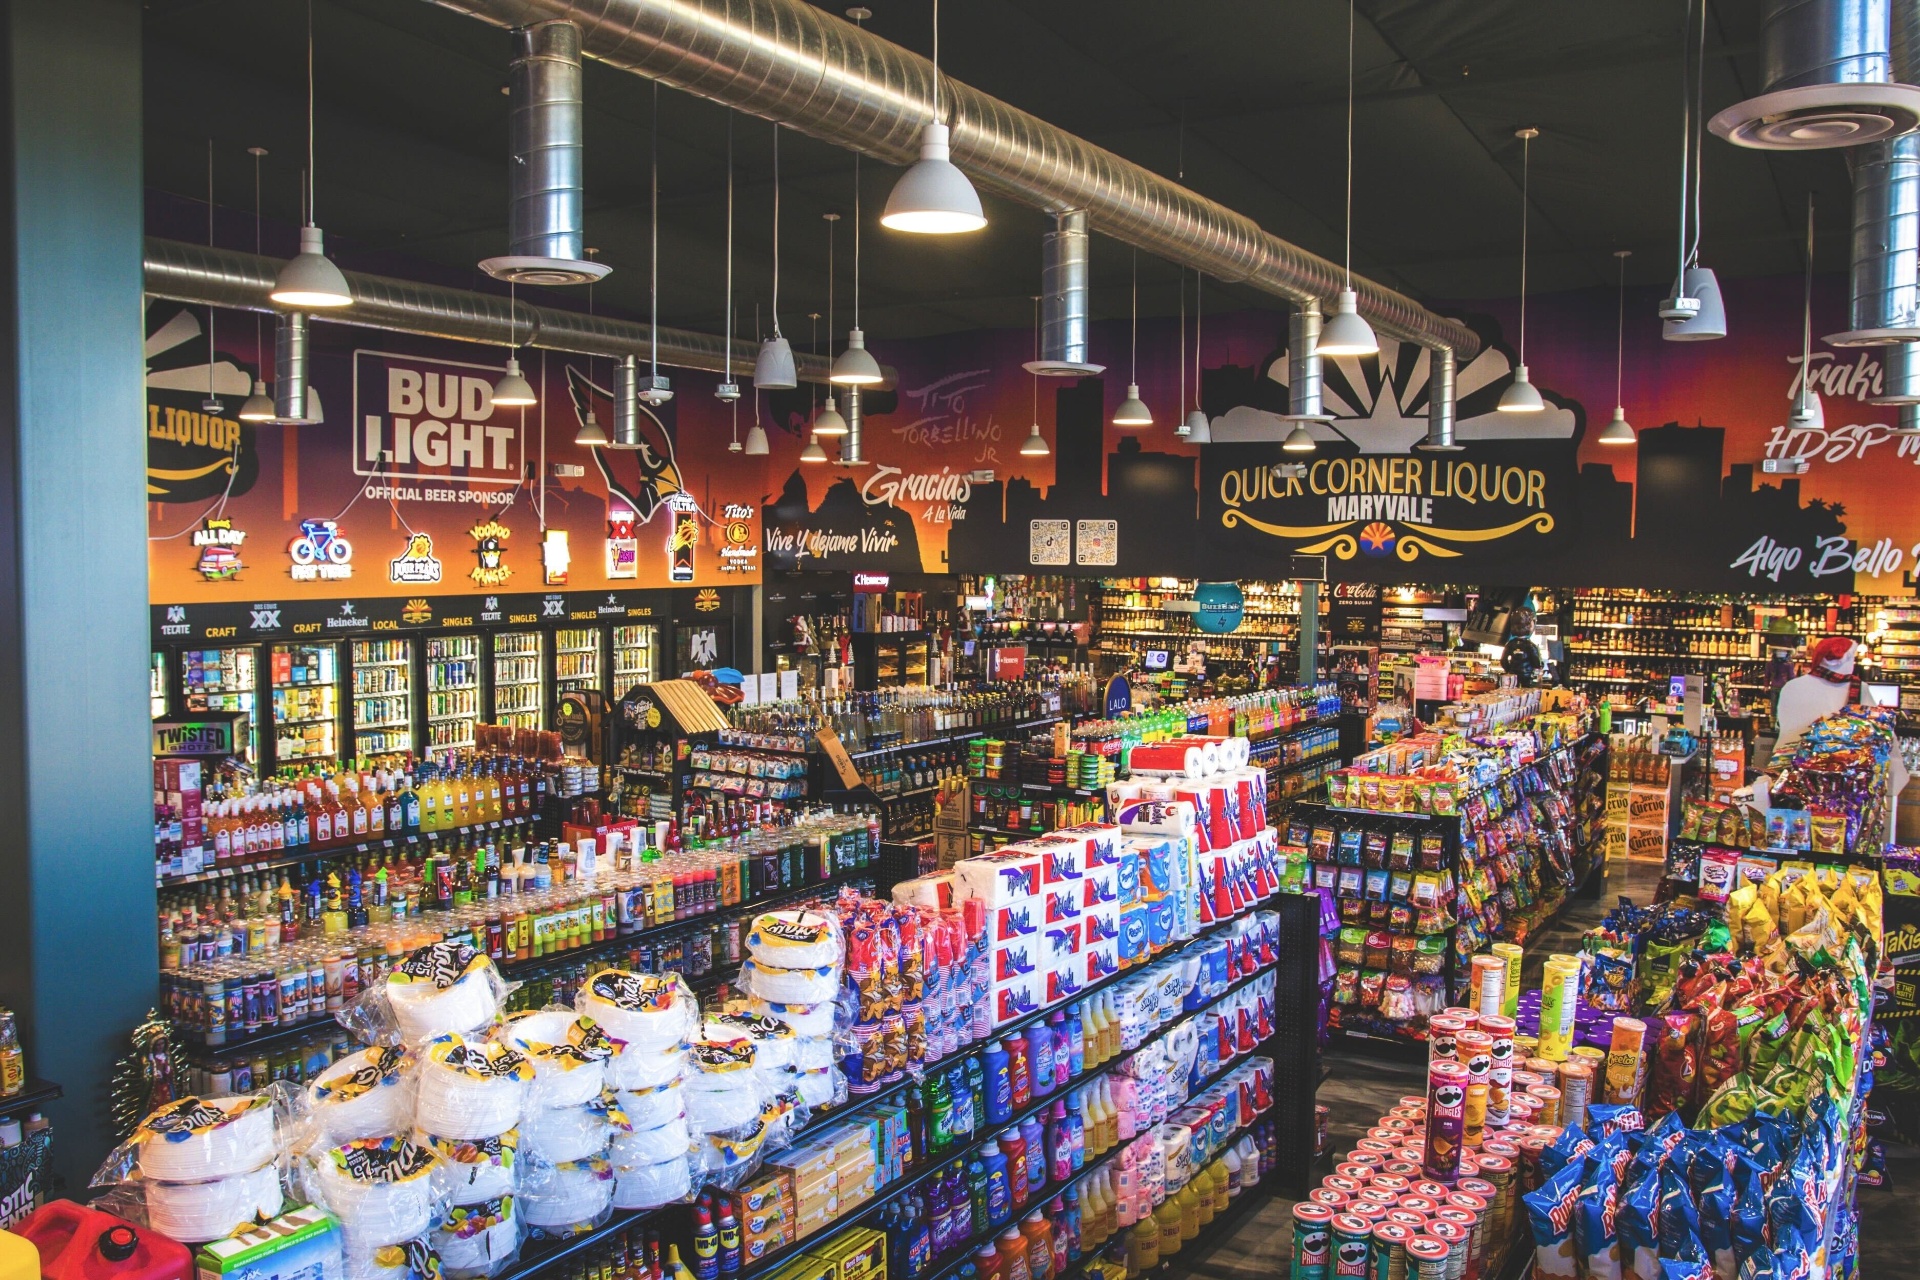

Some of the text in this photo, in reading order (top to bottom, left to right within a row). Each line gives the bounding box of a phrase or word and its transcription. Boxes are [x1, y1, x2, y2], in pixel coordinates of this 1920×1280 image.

[388, 368, 493, 422] BUD
[149, 404, 242, 452] LIQUOR
[365, 415, 514, 471] LIGHT
[862, 464, 973, 507] Gracias
[1221, 458, 1547, 509] QUICK CORNER LIQUOR
[365, 486, 514, 505] OFFICIAL BEER SPONSOR
[672, 500, 697, 512] ULTRA
[725, 504, 754, 518] Tito's
[934, 507, 945, 523] La
[947, 504, 966, 520] Vida
[1328, 494, 1433, 524] MARYVALE
[193, 529, 246, 546] ALL DAY
[470, 521, 511, 541] VOODOO
[766, 526, 897, 558] Vive Y dejame Vivir
[1730, 536, 1802, 582] Algo
[1810, 535, 1903, 578] Bello
[471, 565, 512, 584] RANGER
[1334, 582, 1378, 600] Coca-Cola
[542, 600, 565, 616] XX
[571, 611, 597, 620] SINGLES
[598, 604, 626, 614] Heineken
[627, 608, 651, 617] SINGLES
[250, 610, 281, 629] XX
[327, 616, 369, 628] Heineken
[442, 617, 473, 627] SINGLES
[481, 612, 502, 621] TECATE
[509, 614, 537, 623] SINGLES
[161, 624, 190, 635] TECATE
[206, 627, 237, 638] CRAFT
[293, 623, 321, 633] CRAFT
[373, 620, 399, 630] LOCAL
[1109, 697, 1127, 711] LALO
[1608, 798, 1628, 810] ervo
[1630, 800, 1665, 817] Cuervo
[1629, 834, 1664, 851] Cuervo
[1883, 929, 1920, 956] Takis
[1902, 984, 1914, 992] THE
[1608, 1053, 1636, 1067] Cheetos
[1434, 1104, 1462, 1118] PRINGLES
[1337, 1261, 1366, 1276] PRINGLES
